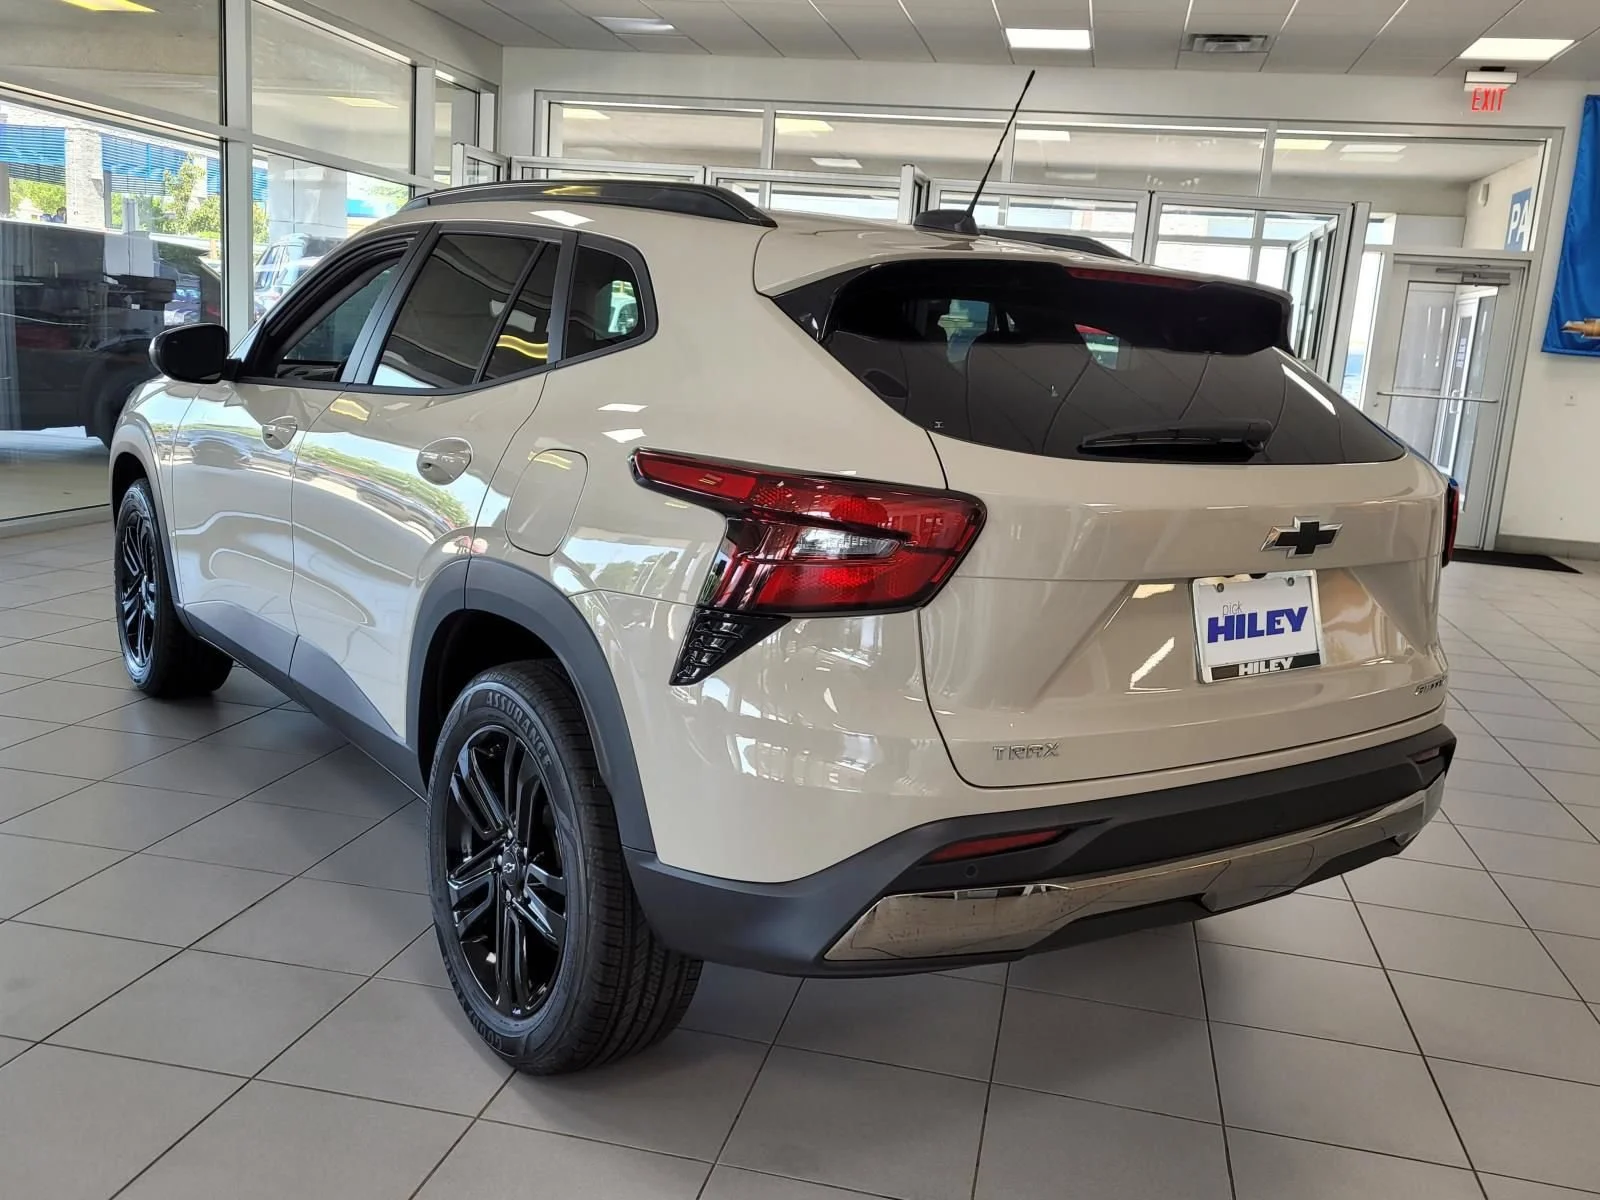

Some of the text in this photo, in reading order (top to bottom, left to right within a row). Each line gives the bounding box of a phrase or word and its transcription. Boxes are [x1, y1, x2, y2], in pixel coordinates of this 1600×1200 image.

[1472, 87, 1507, 112] EXIT
[1222, 601, 1242, 617] pick
[1207, 606, 1308, 643] HILEY
[1238, 656, 1294, 676] HILEY
[486, 691, 552, 766] ASSURANCE
[993, 742, 1060, 760] TRAX
